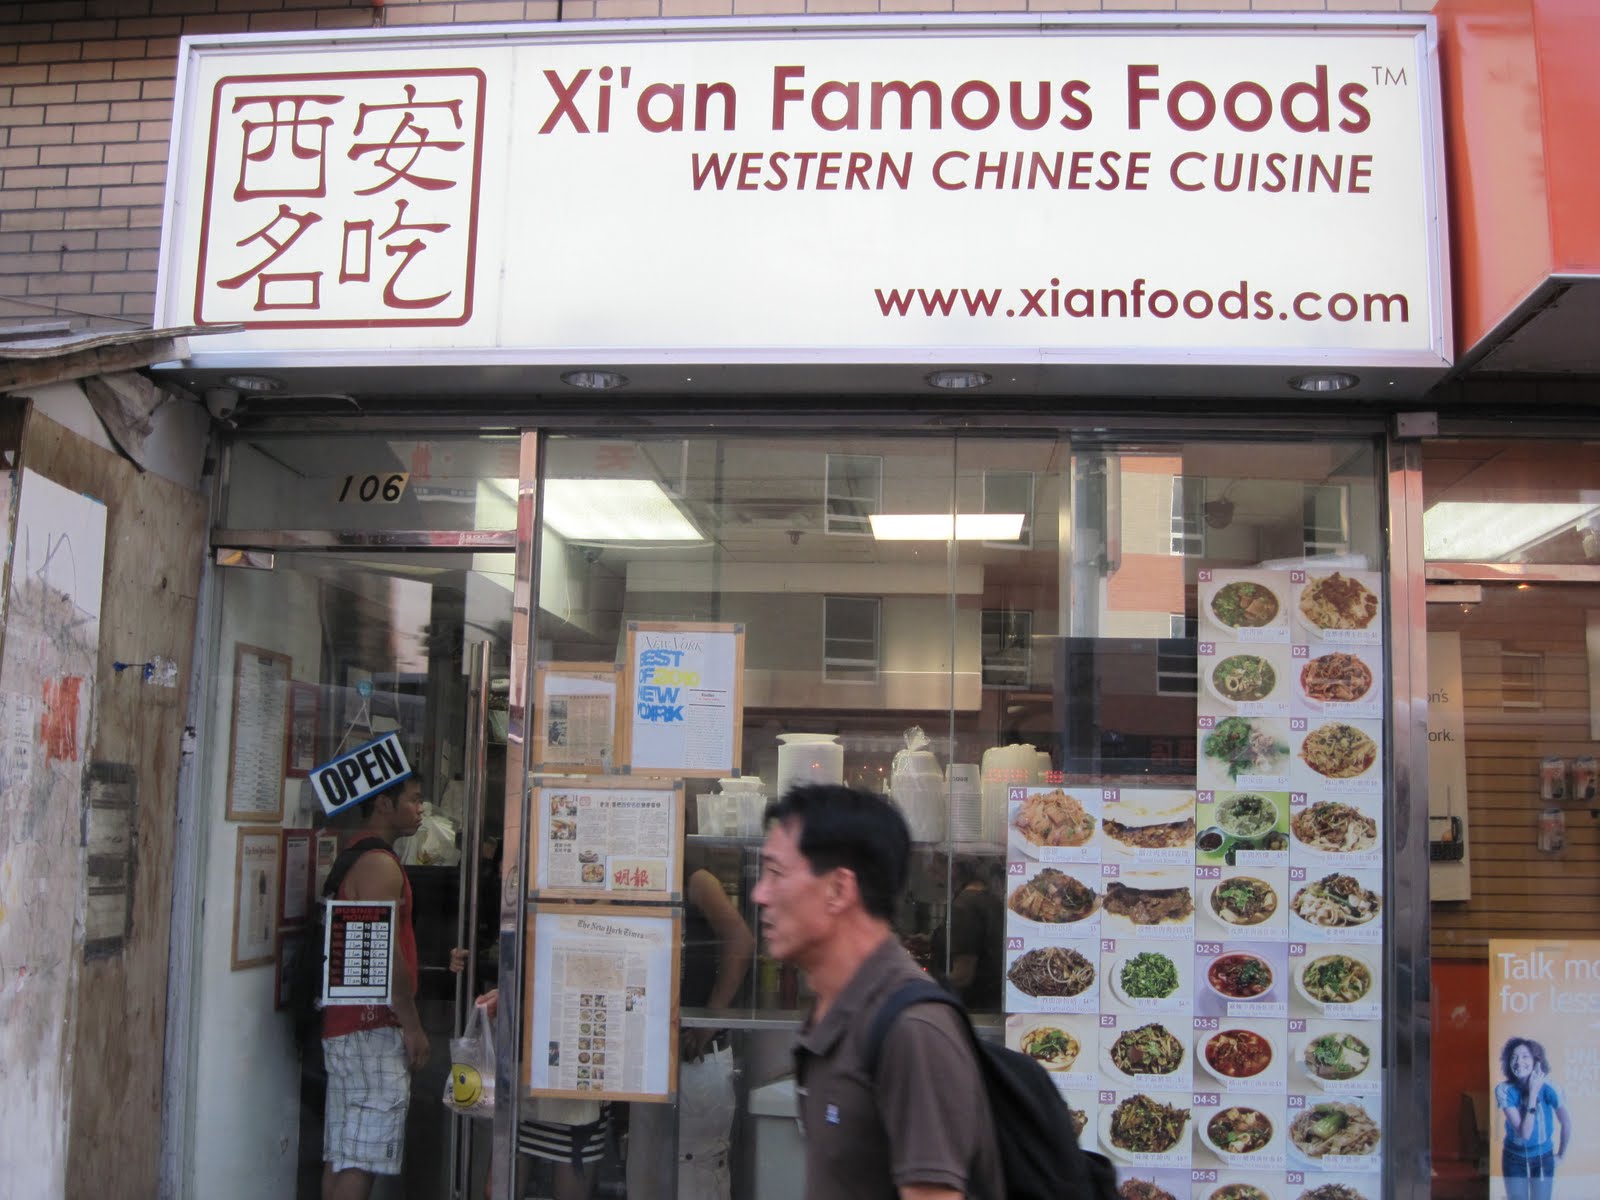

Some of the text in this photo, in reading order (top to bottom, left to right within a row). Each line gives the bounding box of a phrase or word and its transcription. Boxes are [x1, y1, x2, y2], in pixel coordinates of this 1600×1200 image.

[538, 66, 736, 134] Xi'an
[772, 65, 1093, 132] Famous
[1128, 65, 1371, 134] Foods
[231, 84, 466, 203] 西安
[691, 150, 1374, 194] WESTERN CHINESE CUISINE
[216, 198, 452, 312] 名吃
[874, 277, 1410, 323] www.xianfoods.com
[338, 474, 405, 502] 106
[1199, 571, 1212, 580] C1
[1291, 572, 1305, 581] D1
[1199, 644, 1213, 653] C2
[1293, 647, 1307, 656] D2
[1199, 718, 1212, 727] C3
[1291, 720, 1305, 729] D3
[319, 738, 405, 806] OPEN
[1010, 790, 1024, 799] A1
[1104, 790, 1117, 800] B1
[1198, 792, 1212, 801] C4
[1291, 794, 1305, 803] D4
[1009, 864, 1023, 873] A2
[1103, 865, 1117, 874] B2
[1196, 868, 1220, 877] D1-S
[1291, 869, 1304, 878] D5
[591, 921, 605, 931] New
[605, 924, 623, 936] York
[623, 927, 644, 939] Times
[1008, 939, 1022, 948] A3
[1101, 941, 1114, 950] E1
[1196, 944, 1220, 953] D2-S
[1290, 944, 1304, 953] D6
[1497, 951, 1554, 980] Talk
[1499, 985, 1541, 1014] for
[1101, 1016, 1114, 1025] E2
[1194, 1018, 1218, 1028] D3-S
[1289, 1021, 1303, 1030] D7
[1100, 1092, 1113, 1101] E3
[1193, 1095, 1217, 1104] D4-S
[1289, 1096, 1303, 1106] D8
[1192, 1171, 1216, 1180] D5-S
[1288, 1173, 1302, 1183] D9
